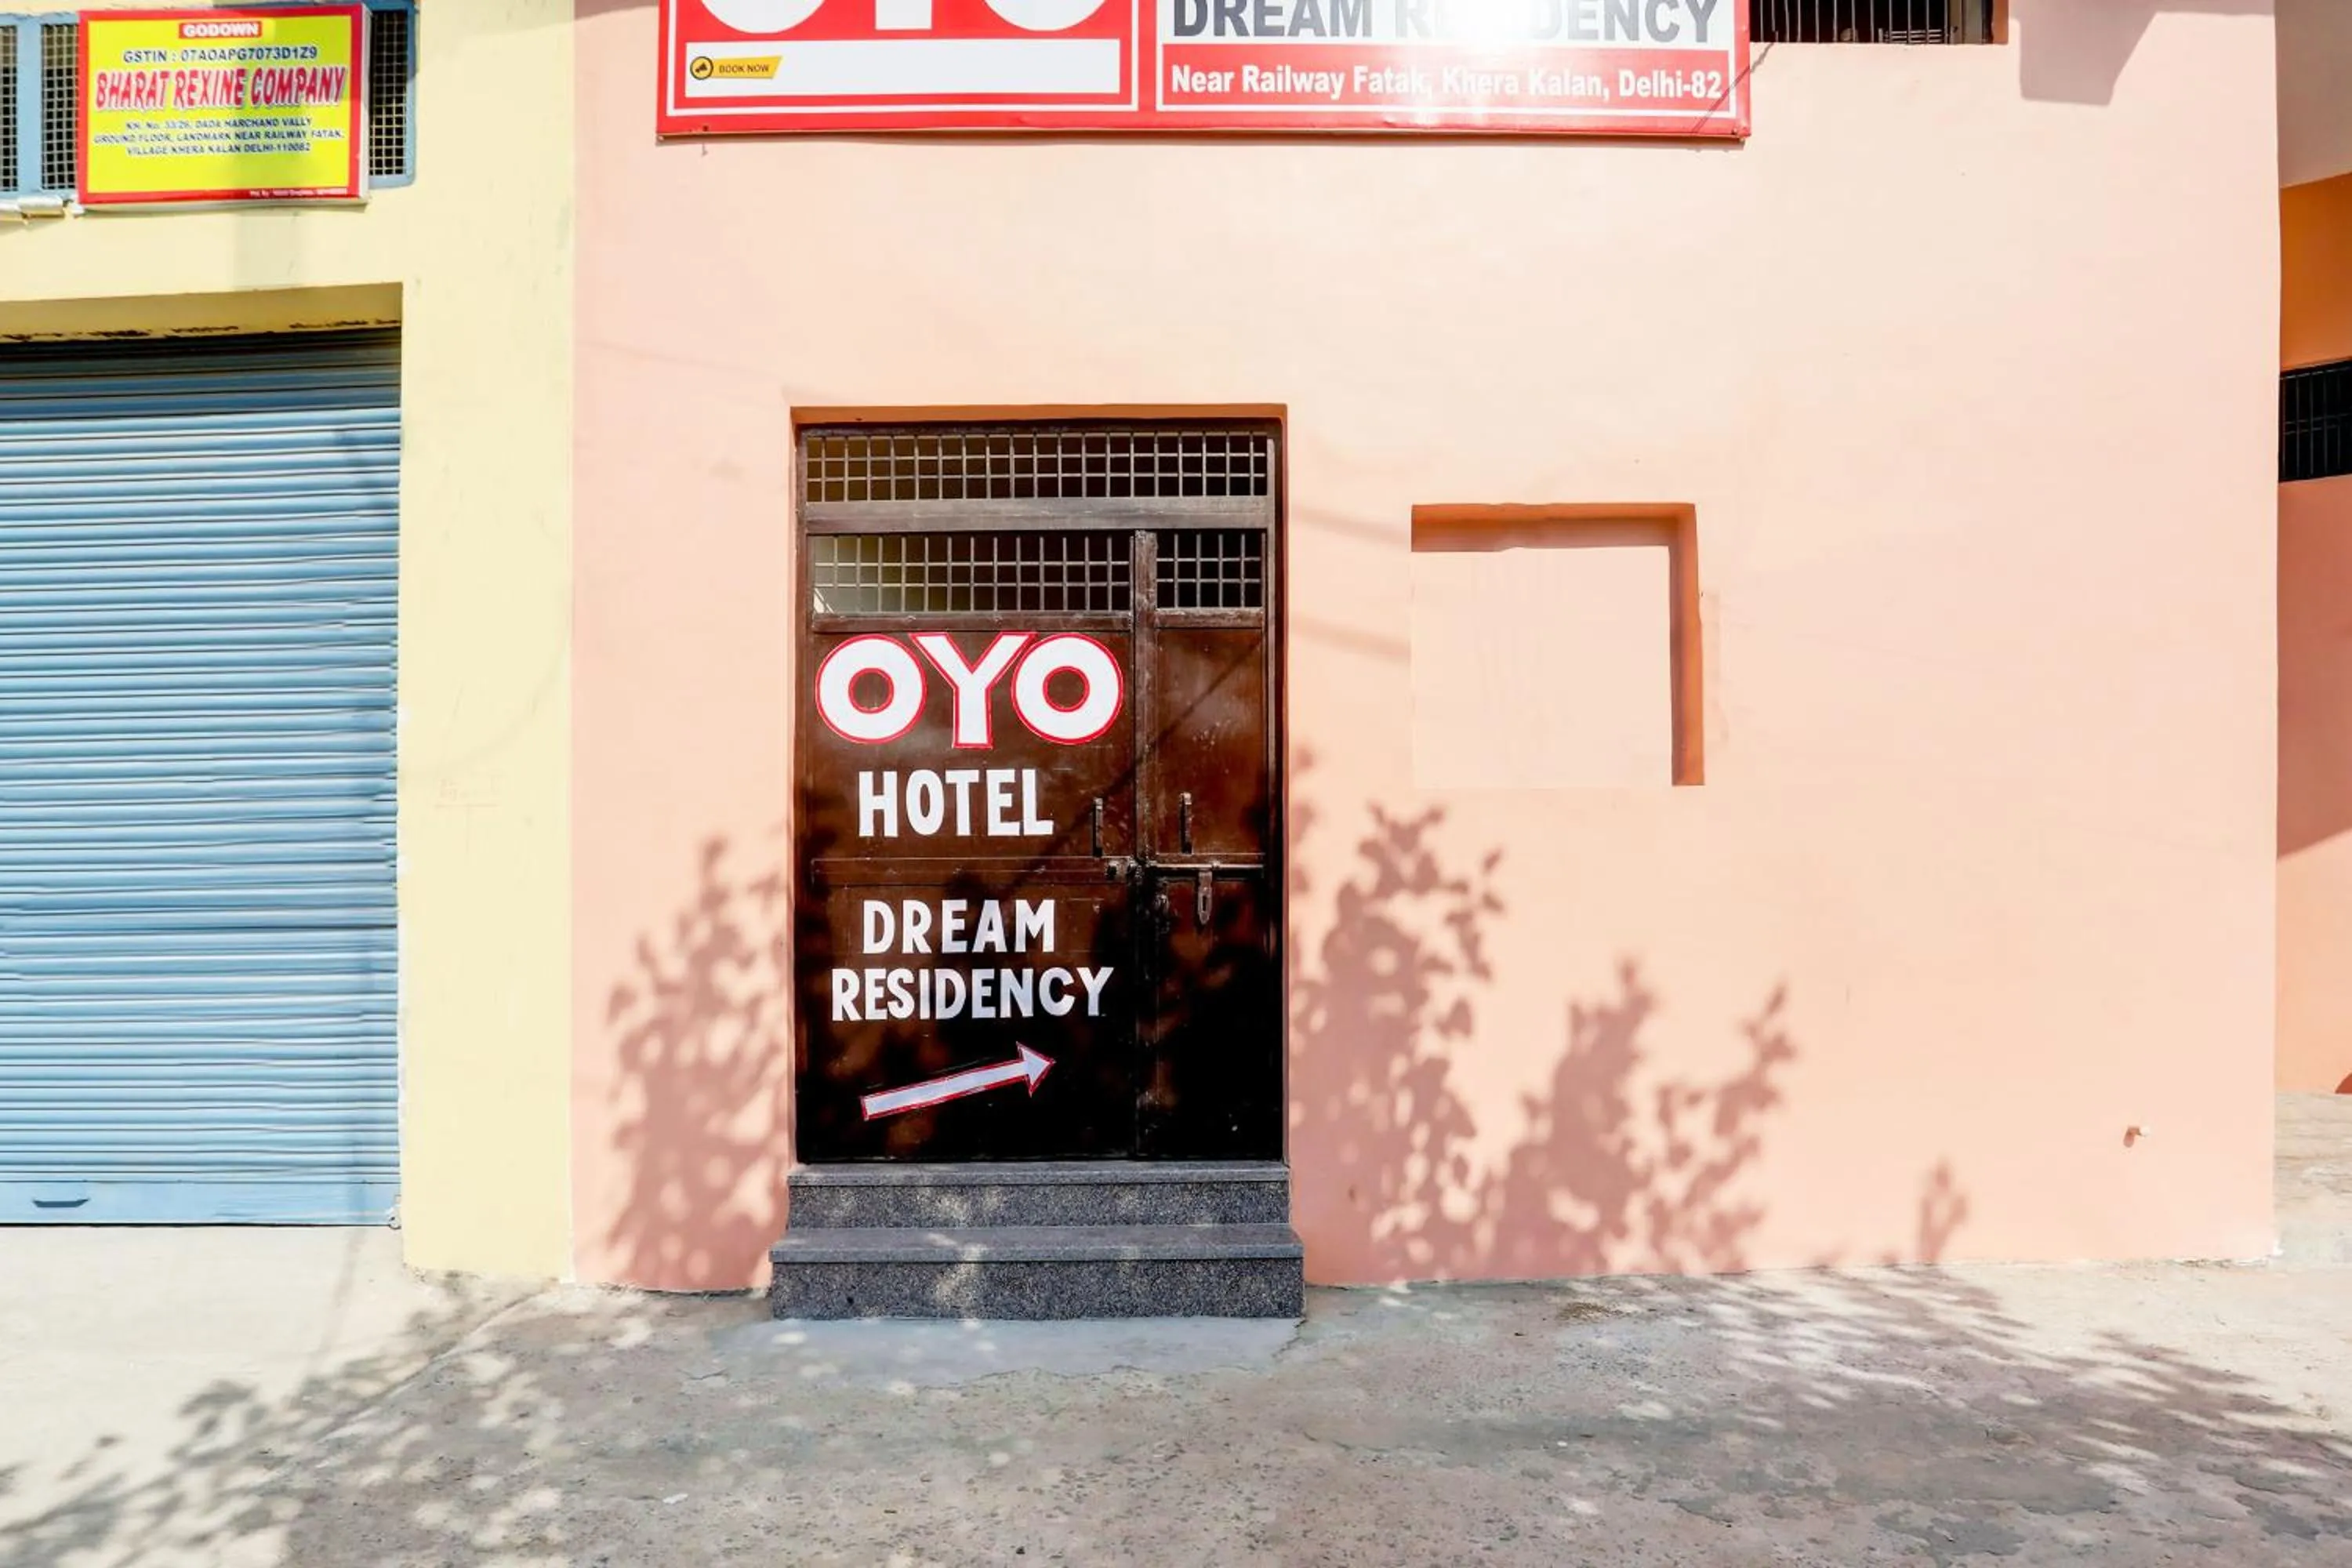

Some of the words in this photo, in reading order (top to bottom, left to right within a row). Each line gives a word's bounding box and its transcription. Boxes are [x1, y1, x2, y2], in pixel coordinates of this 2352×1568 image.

[182, 23, 259, 38] GODOWN
[1174, 0, 1372, 38] DREAM
[123, 49, 167, 63] GSTIN
[719, 64, 746, 74] BOOK
[747, 64, 769, 73] NOW
[96, 70, 171, 111] BHARAT
[173, 68, 248, 109] REXINE
[250, 66, 347, 107] COMPANY
[1171, 64, 1236, 93] Near
[1242, 64, 1347, 100] Railway
[1352, 65, 1433, 100] Fatak,
[1442, 65, 1519, 95] Khera
[1529, 67, 1611, 100] Kalan,
[1618, 69, 1723, 99] Delhi-82
[234, 130, 261, 140] NEAR
[264, 129, 307, 139] RAILWAY
[815, 630, 1124, 750] OYO
[858, 768, 1054, 838] HOTEL
[862, 898, 1056, 954] DREAM
[831, 966, 1115, 1022] RESIDENCY
